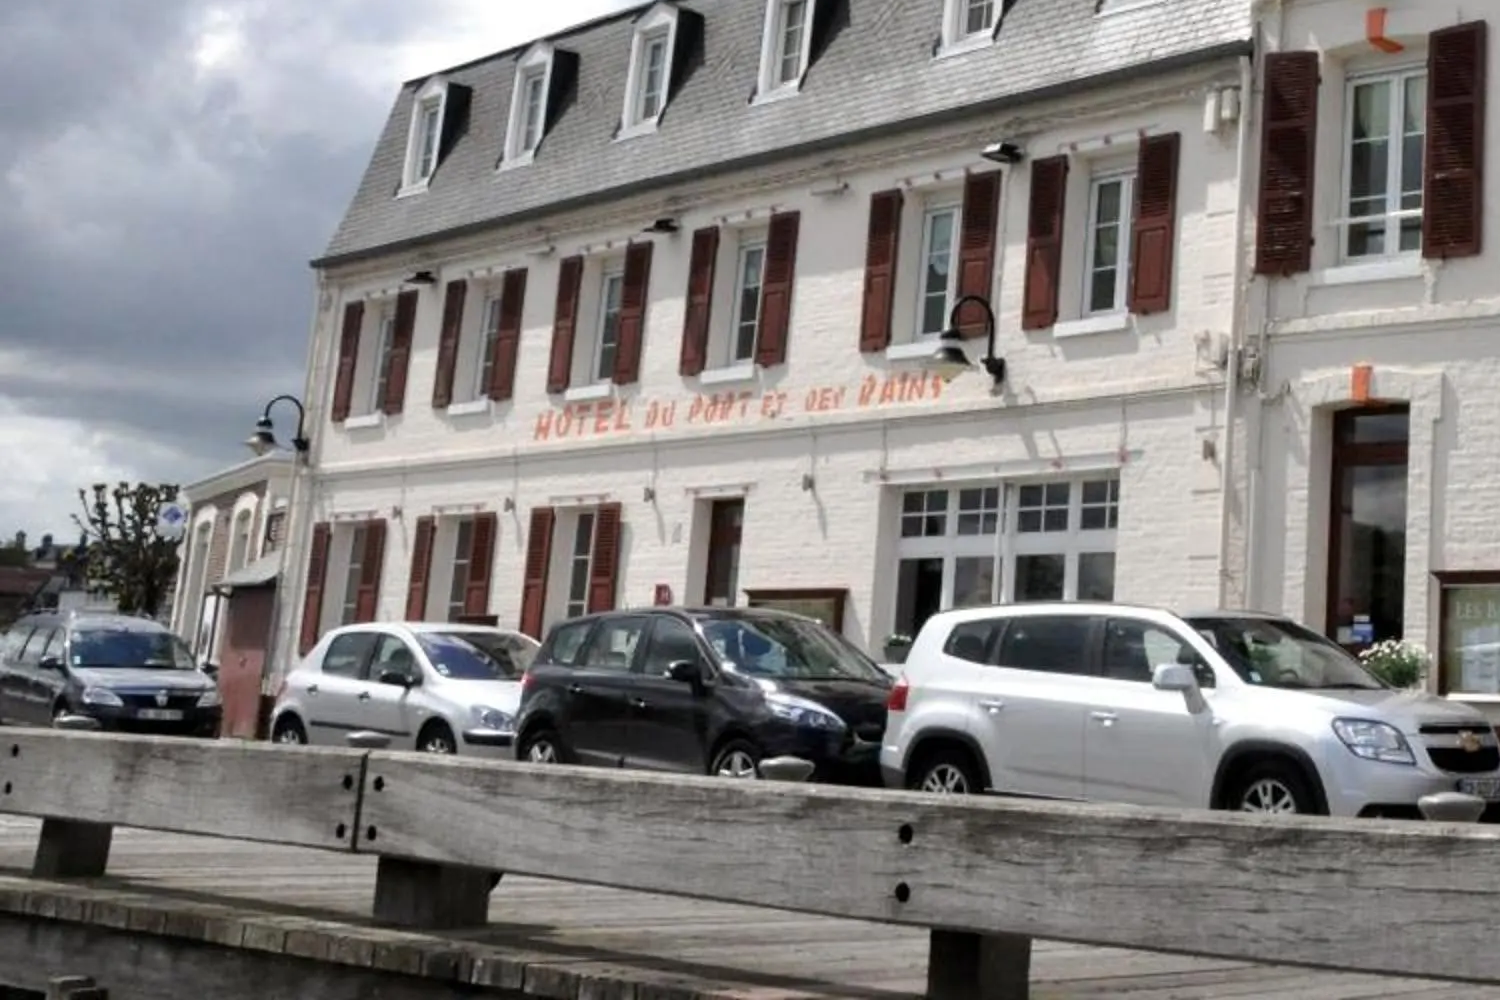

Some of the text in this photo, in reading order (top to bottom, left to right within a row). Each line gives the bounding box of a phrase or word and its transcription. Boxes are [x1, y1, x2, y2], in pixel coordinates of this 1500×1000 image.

[645, 400, 676, 430] DU
[688, 391, 753, 424] PORT
[760, 391, 788, 416] ET
[805, 386, 846, 412] DES
[858, 369, 942, 407] BAINS
